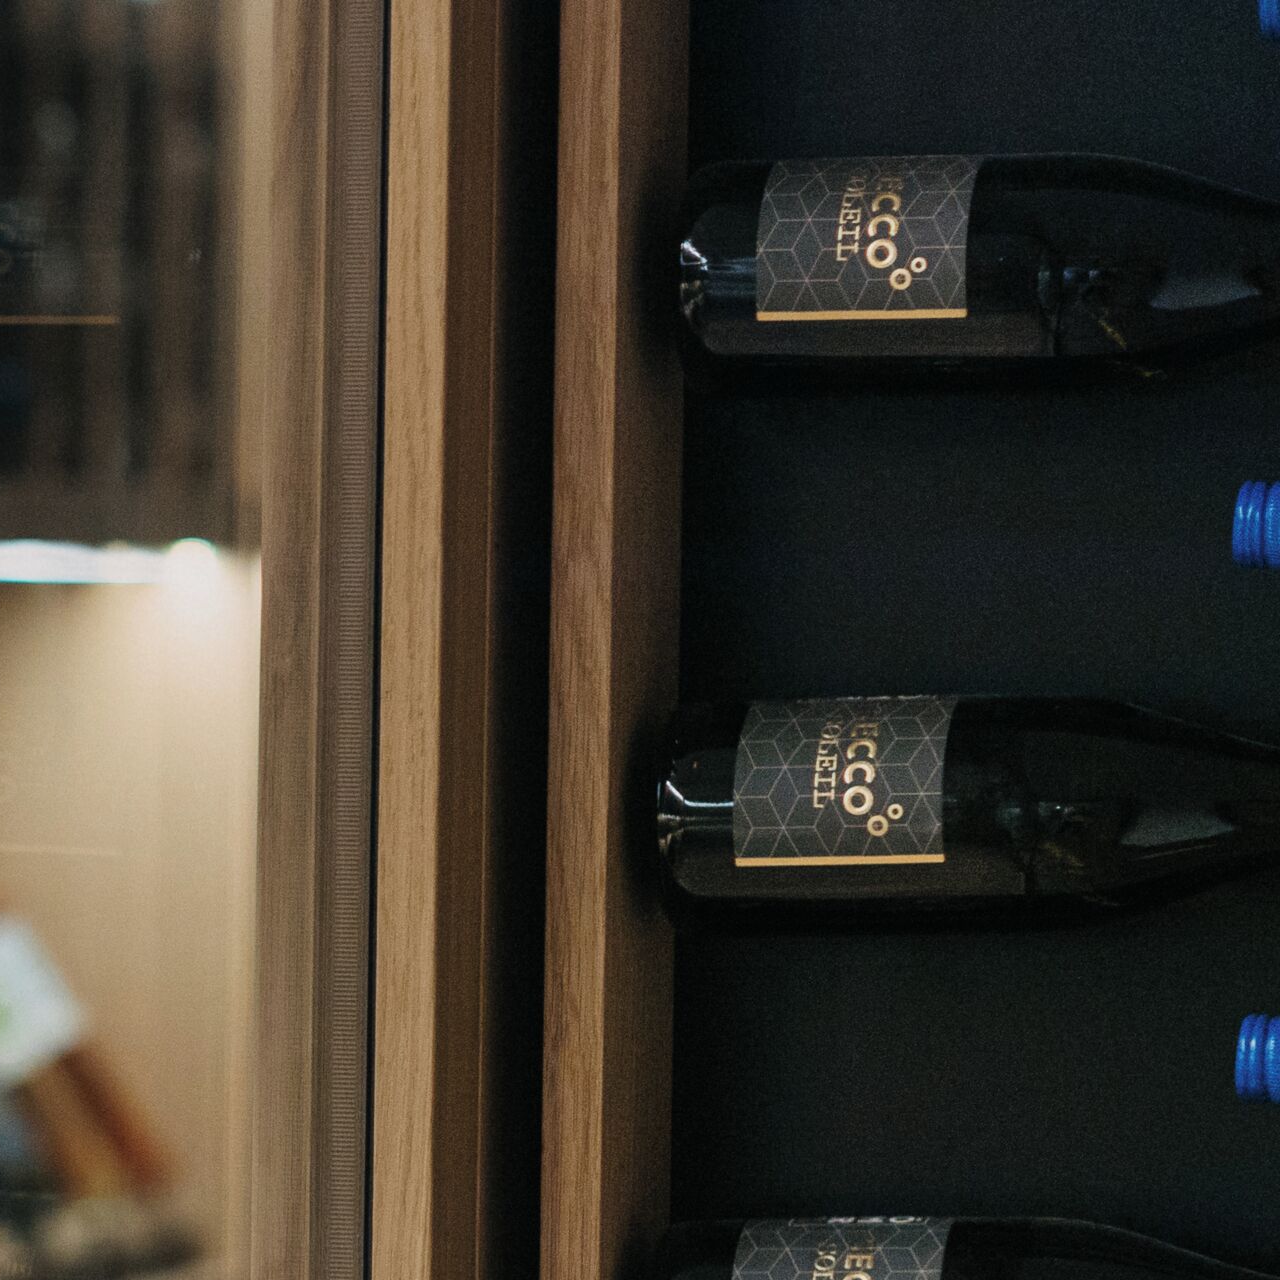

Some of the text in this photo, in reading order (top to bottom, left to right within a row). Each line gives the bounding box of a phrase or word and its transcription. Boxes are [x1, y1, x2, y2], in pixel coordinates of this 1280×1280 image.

[836, 176, 865, 262] OLEIL
[867, 177, 902, 269] ECCO
[813, 720, 842, 809] OLEIL
[843, 723, 879, 816] ECCO
